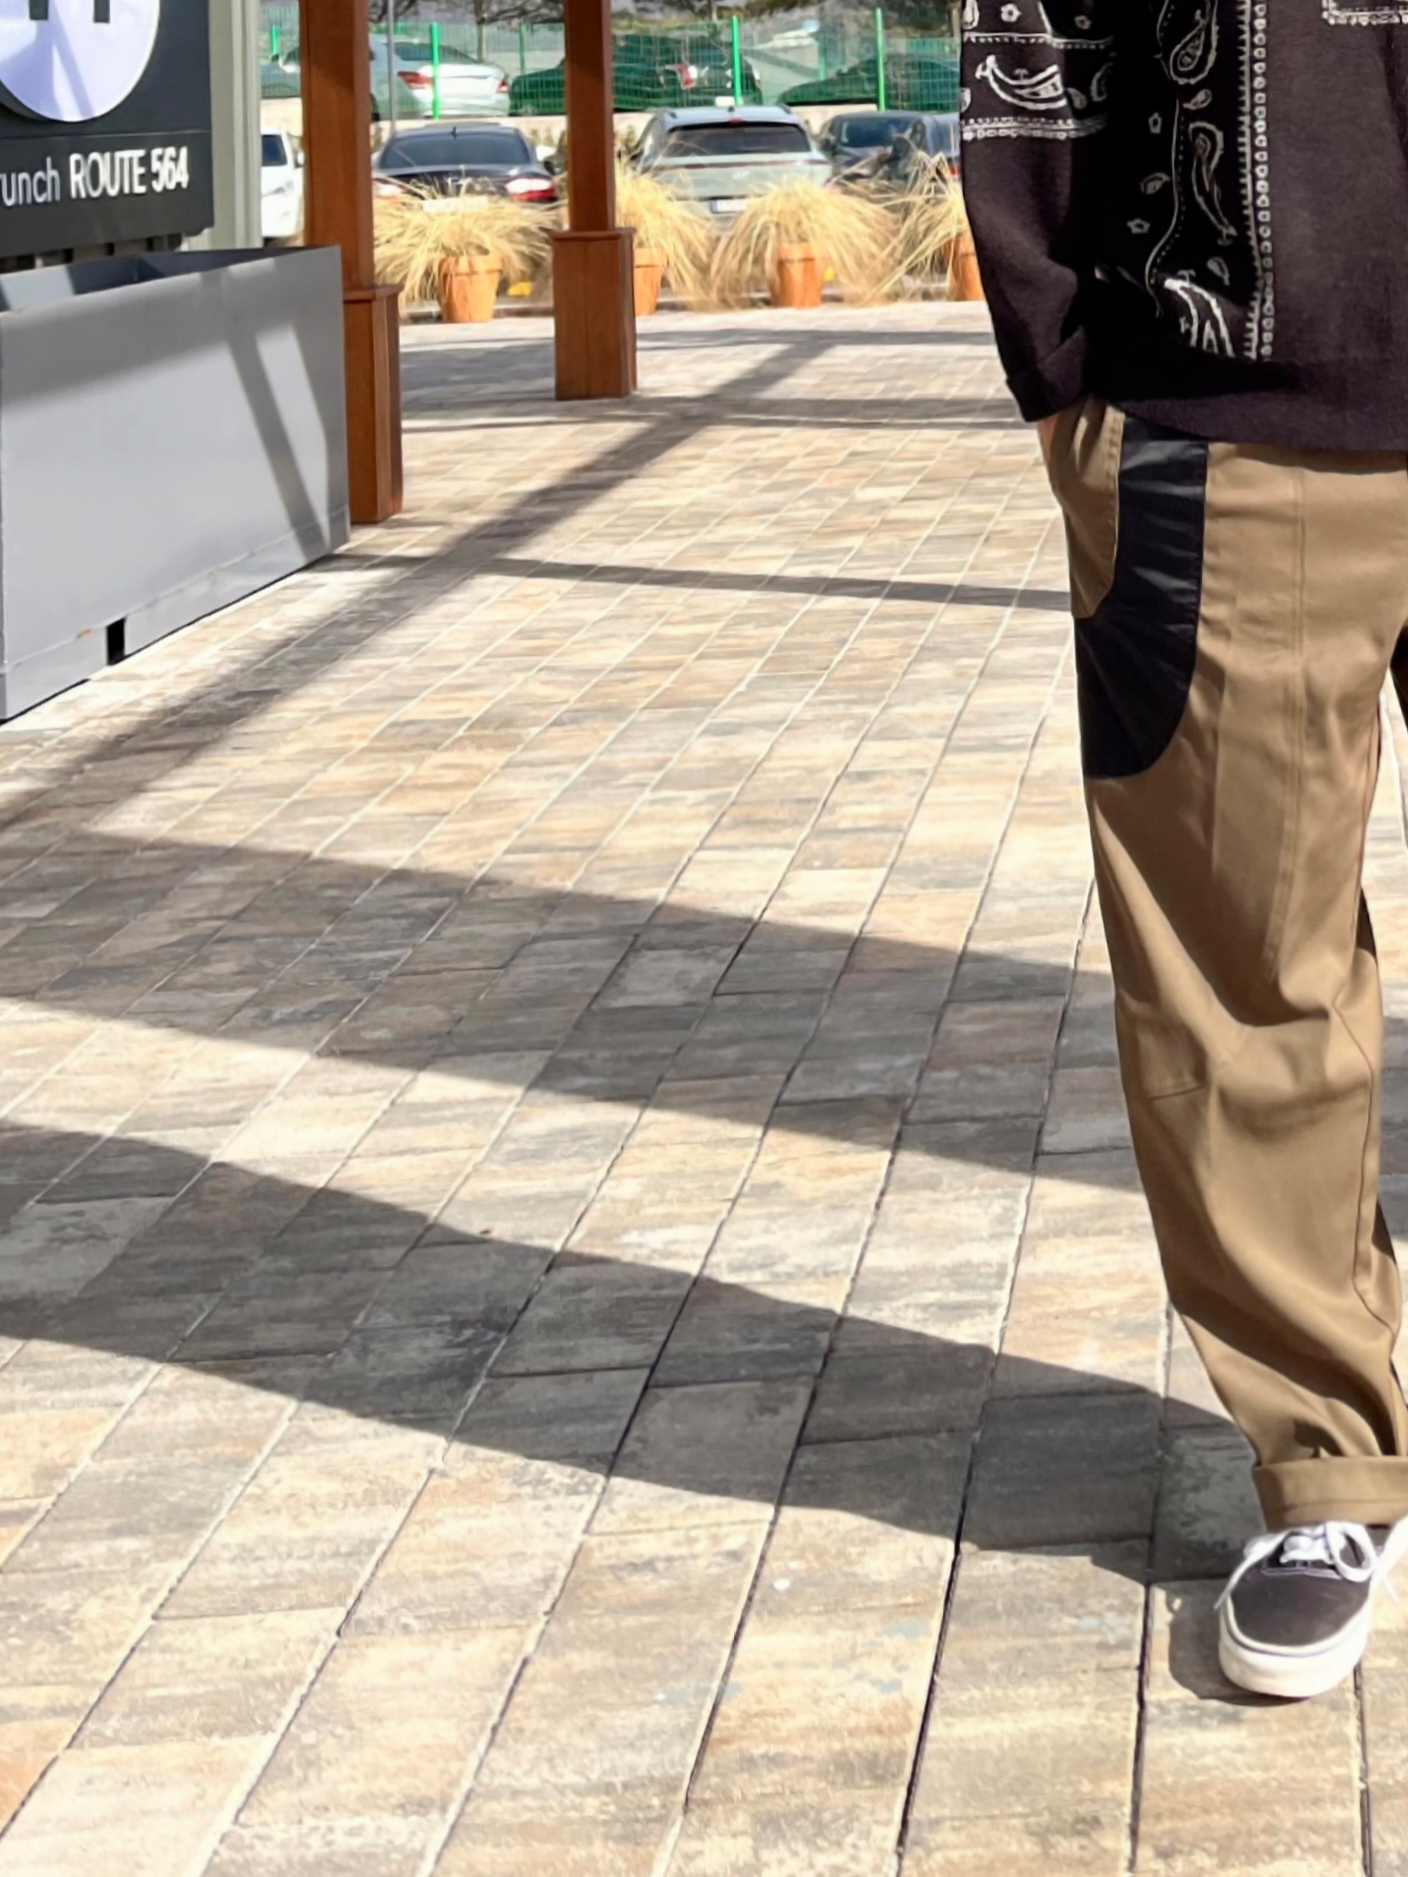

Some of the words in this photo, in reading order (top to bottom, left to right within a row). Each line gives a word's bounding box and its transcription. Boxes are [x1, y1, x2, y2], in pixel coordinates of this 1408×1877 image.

[0, 156, 60, 206] unch
[70, 149, 147, 199] ROUTE
[150, 145, 190, 193] 564
